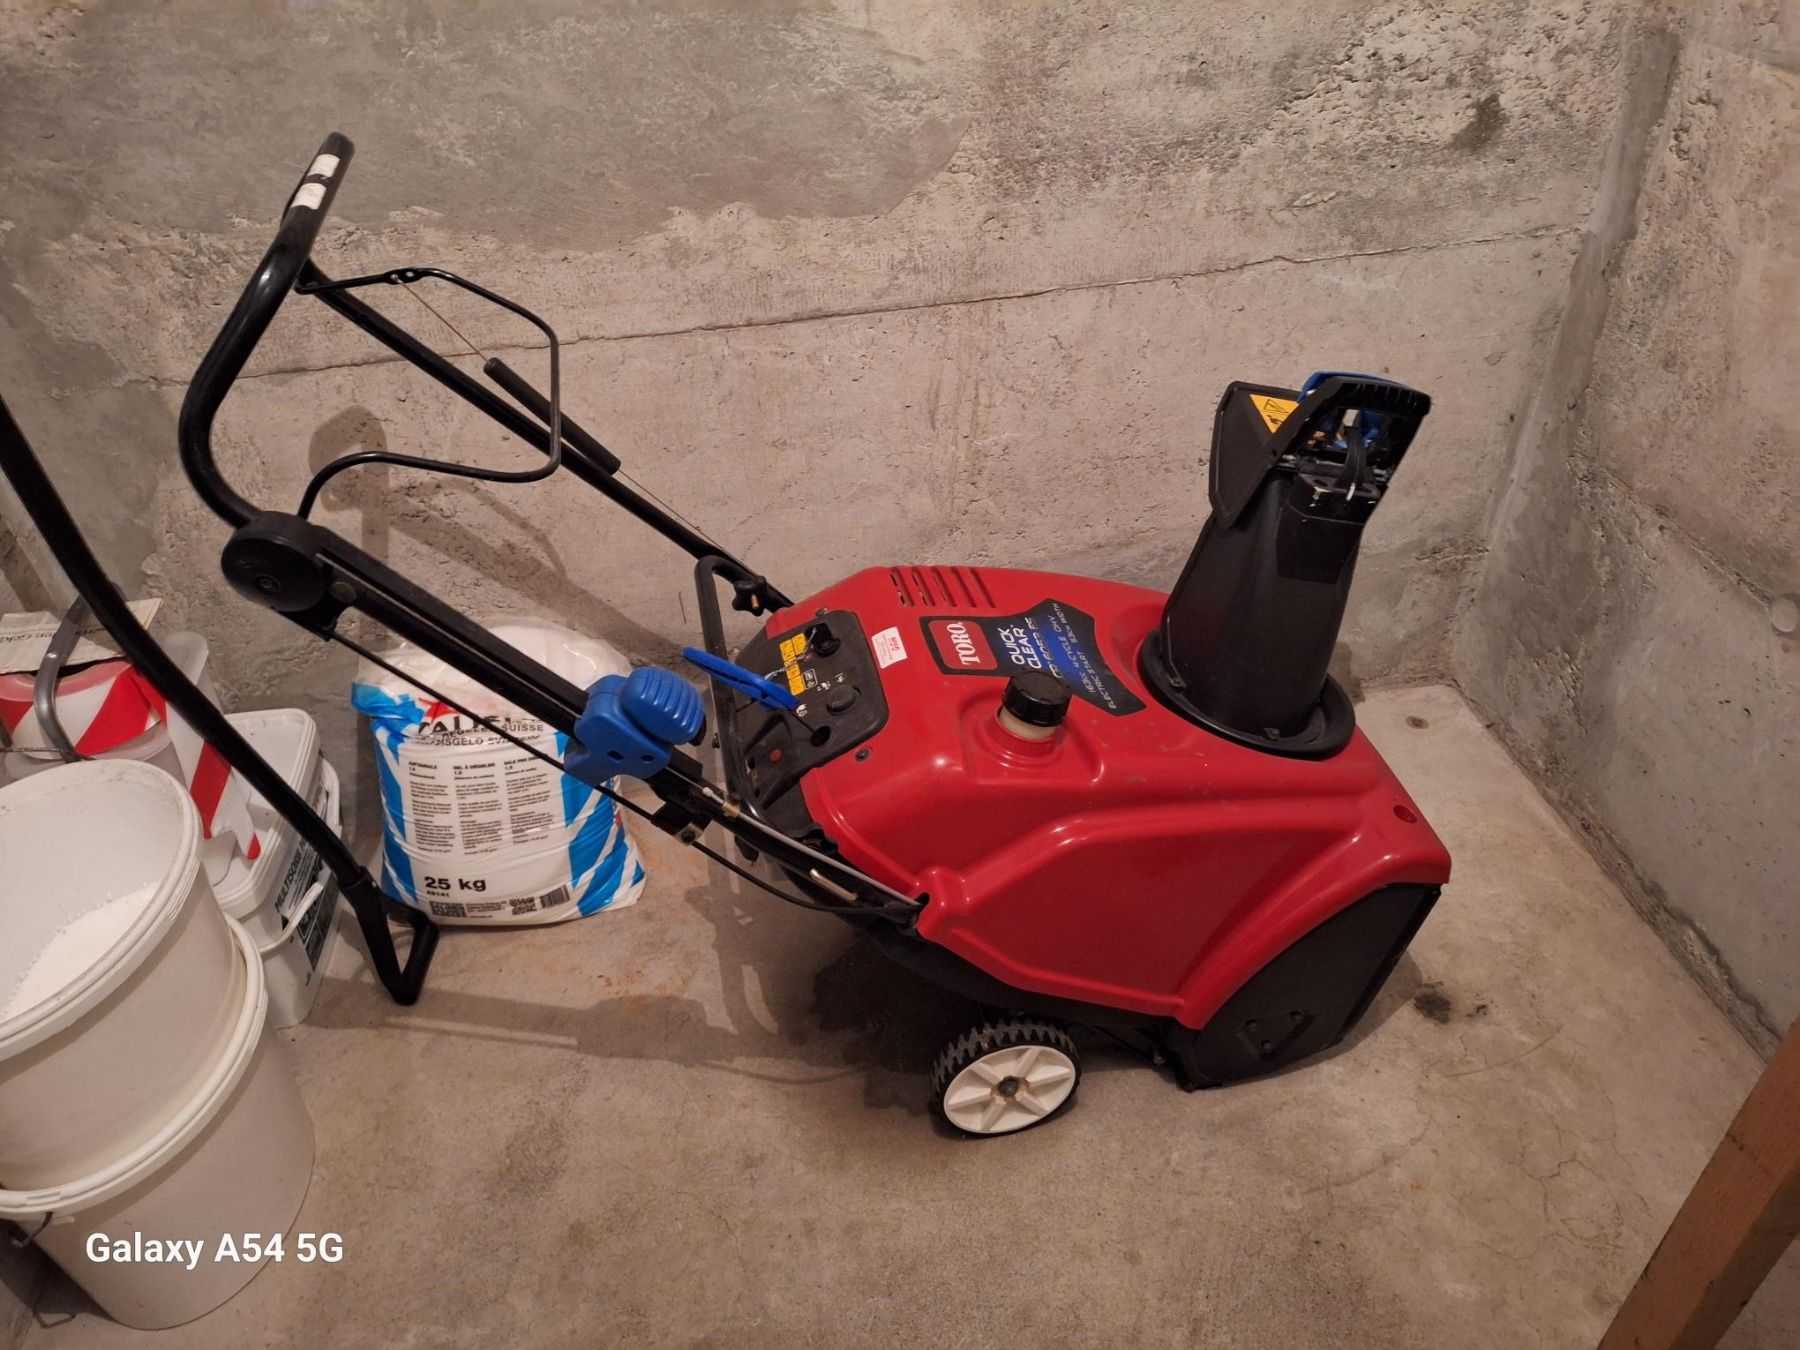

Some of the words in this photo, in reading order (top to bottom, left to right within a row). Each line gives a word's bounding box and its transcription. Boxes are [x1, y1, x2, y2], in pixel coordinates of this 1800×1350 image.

[1047, 614, 1062, 633] OHV
[947, 623, 981, 665] TORO
[997, 627, 1025, 665] QUICK
[1077, 650, 1096, 674] START
[1090, 675, 1117, 709] ELECTRIC
[424, 876, 451, 890] 25
[459, 878, 486, 891] kg
